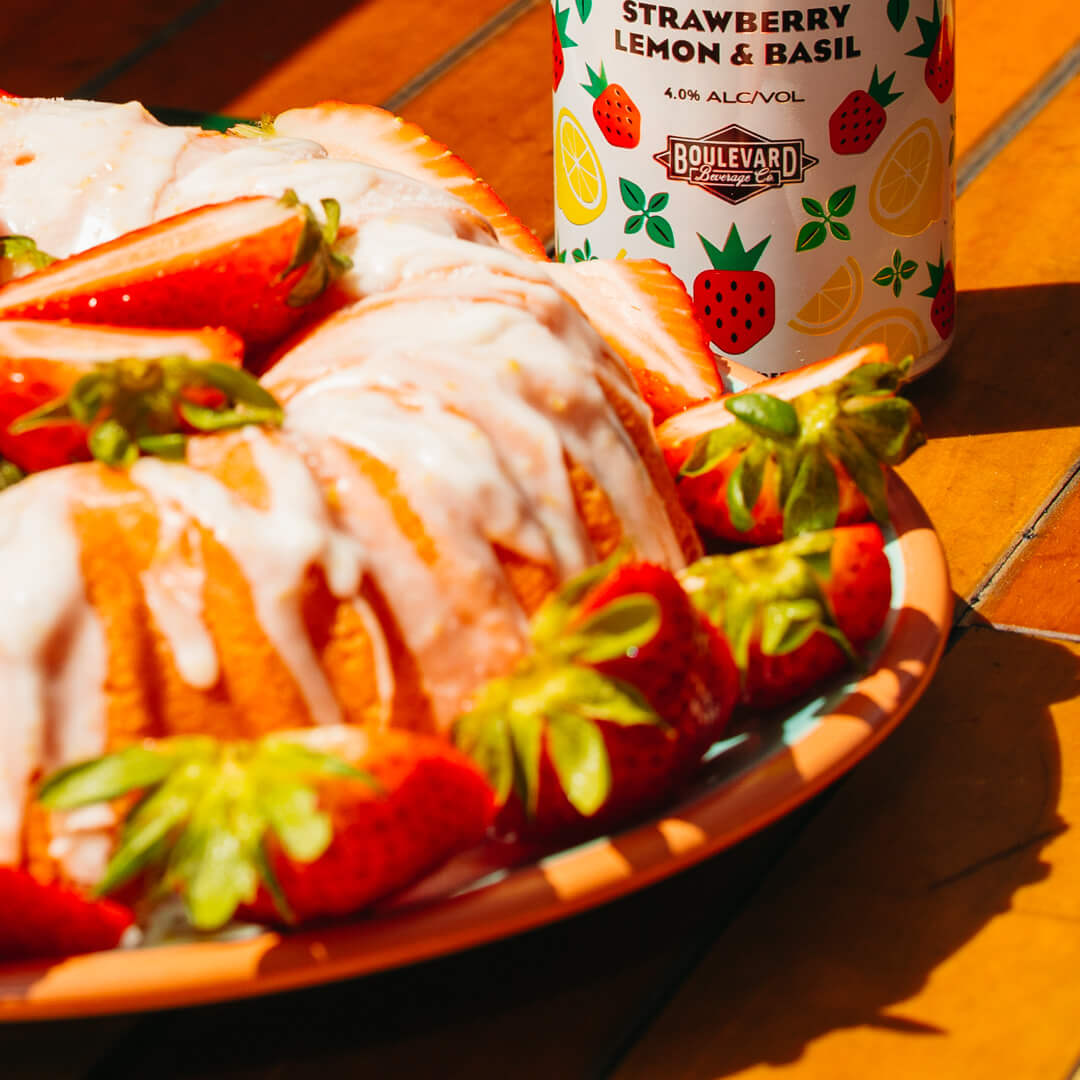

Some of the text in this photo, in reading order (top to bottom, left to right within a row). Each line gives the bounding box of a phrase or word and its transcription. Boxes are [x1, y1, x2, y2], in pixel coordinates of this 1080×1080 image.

[622, 0, 851, 34] STRAWBERRY
[614, 28, 861, 66] LEMON & BASIL
[664, 87, 806, 104] 4.0% ALC/VOL
[674, 143, 797, 177] BOULEVARD
[694, 164, 751, 187] Beverage
